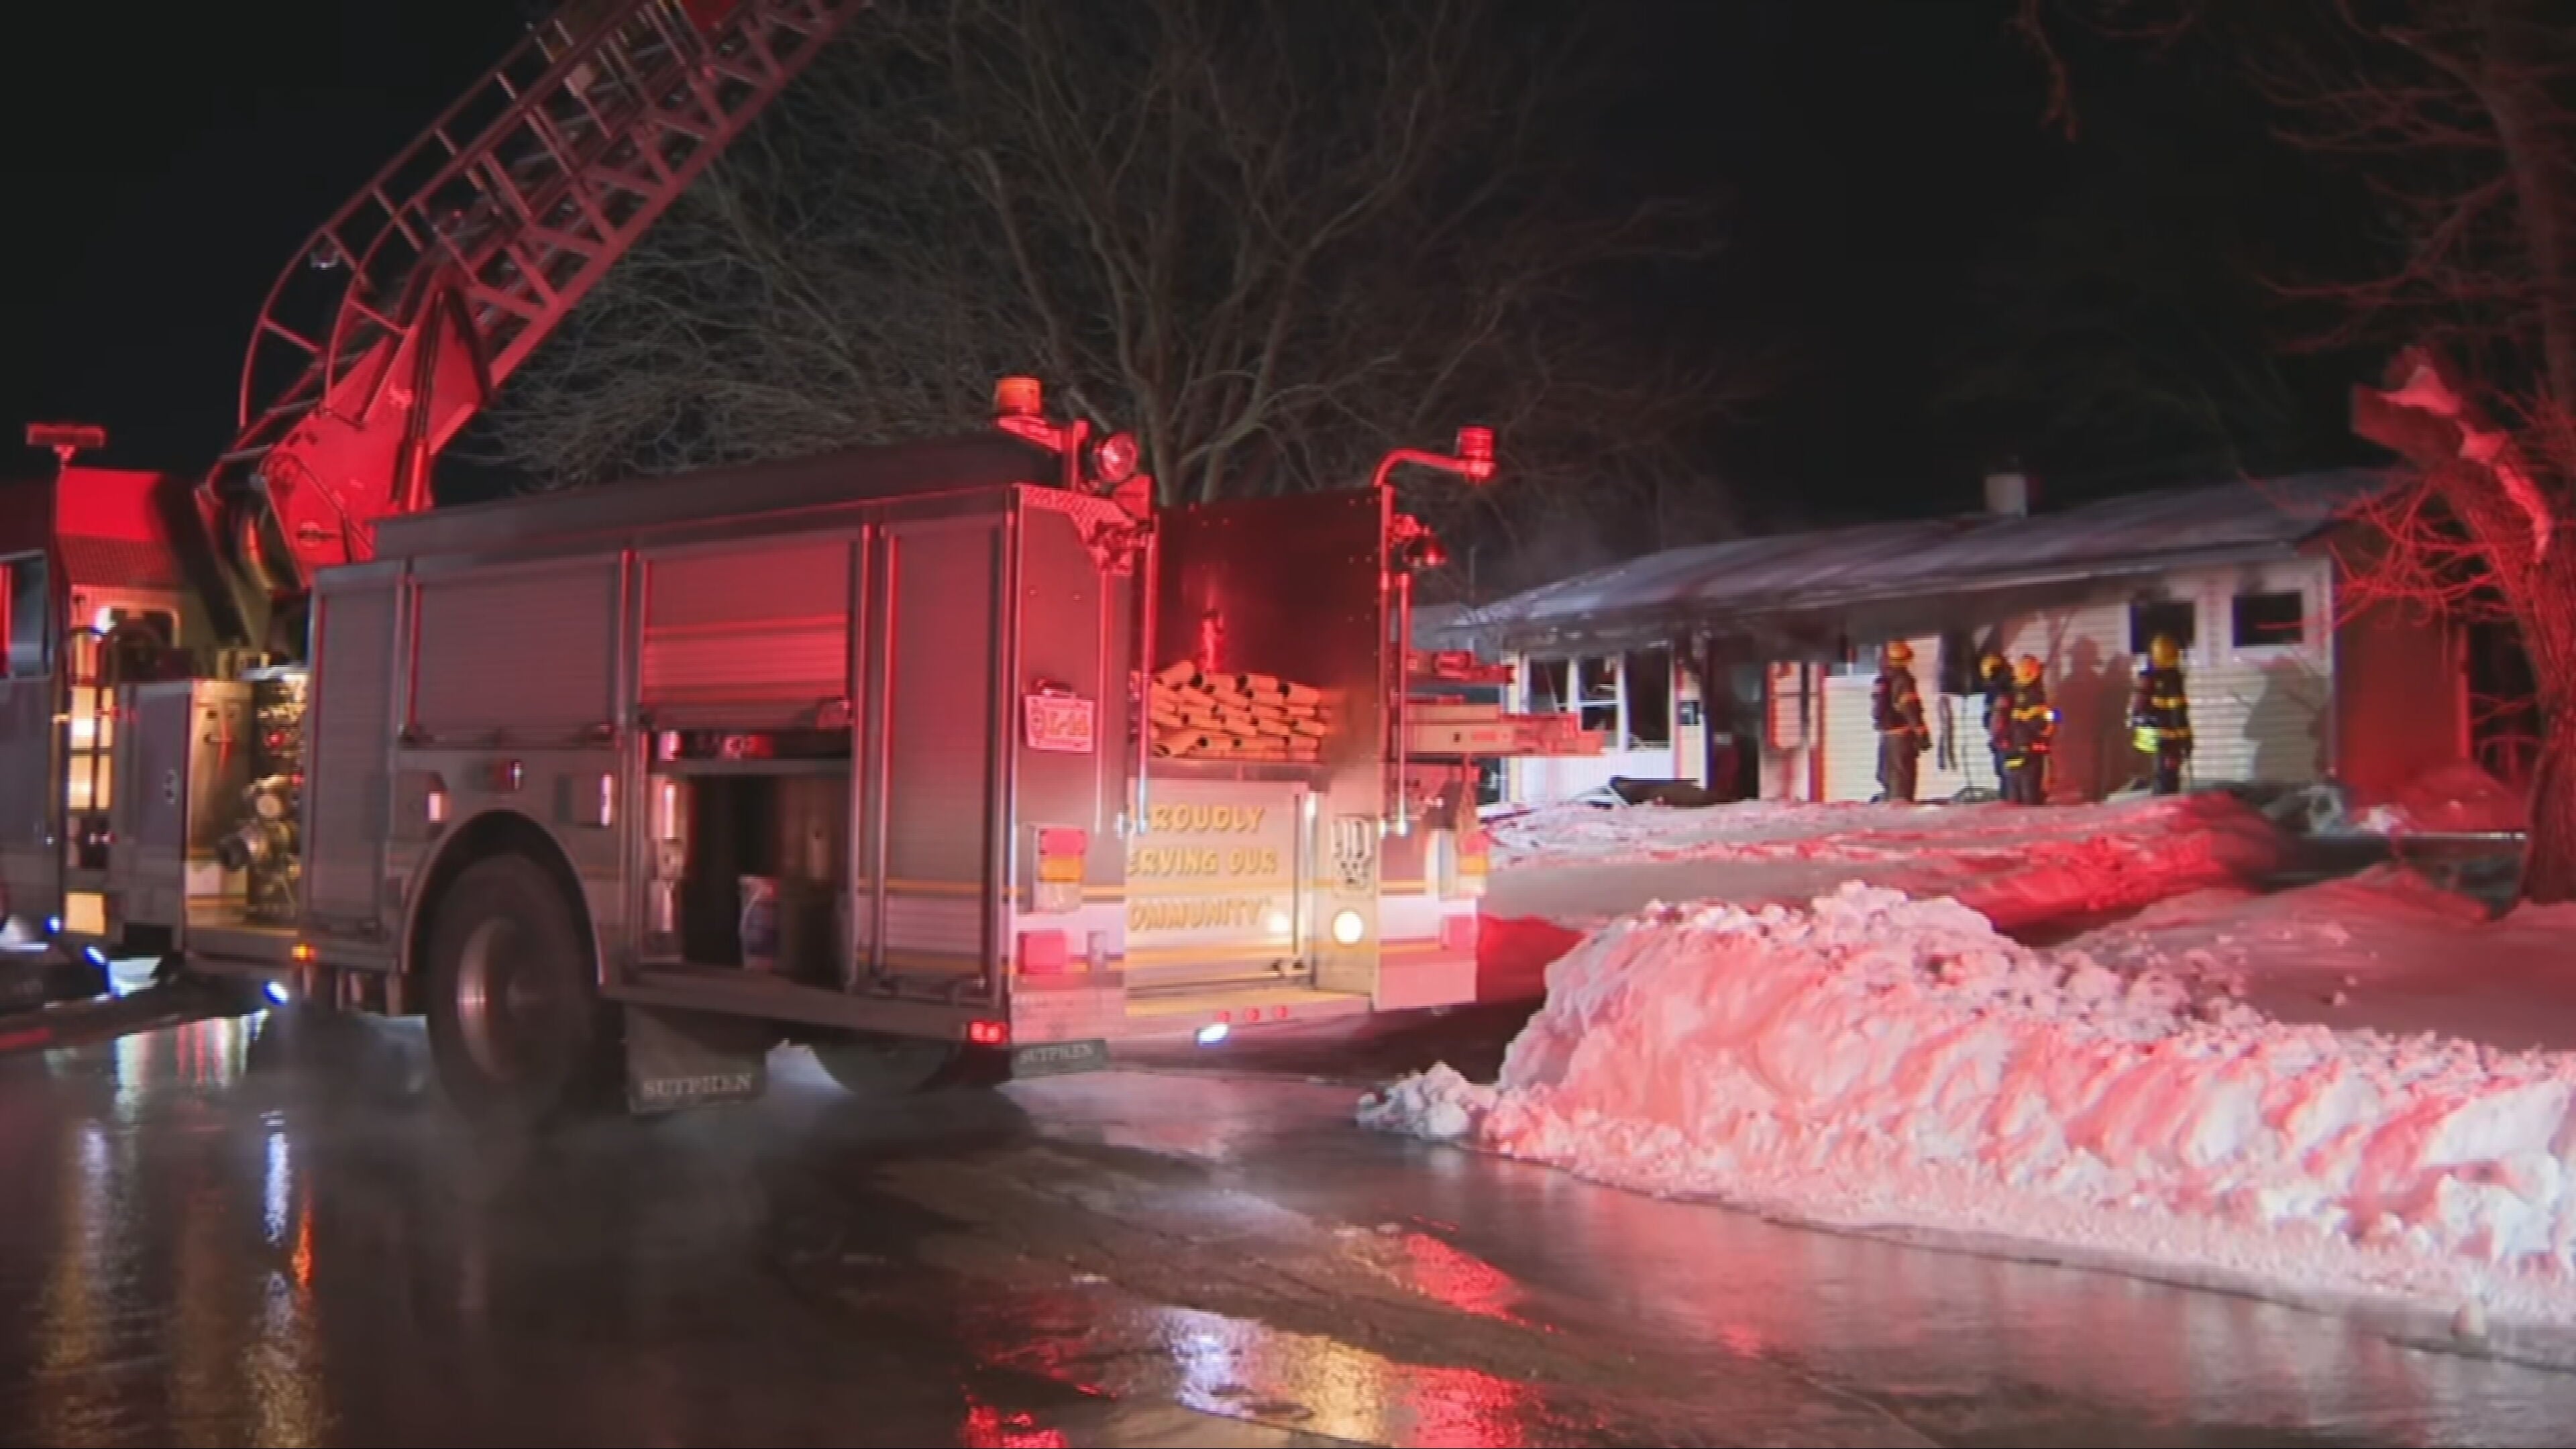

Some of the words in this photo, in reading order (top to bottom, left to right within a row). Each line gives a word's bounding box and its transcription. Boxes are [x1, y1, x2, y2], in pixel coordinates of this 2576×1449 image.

[1128, 847, 1218, 875] ERVING
[1228, 848, 1277, 875] OUR
[643, 1073, 752, 1099] SUTPHEN
